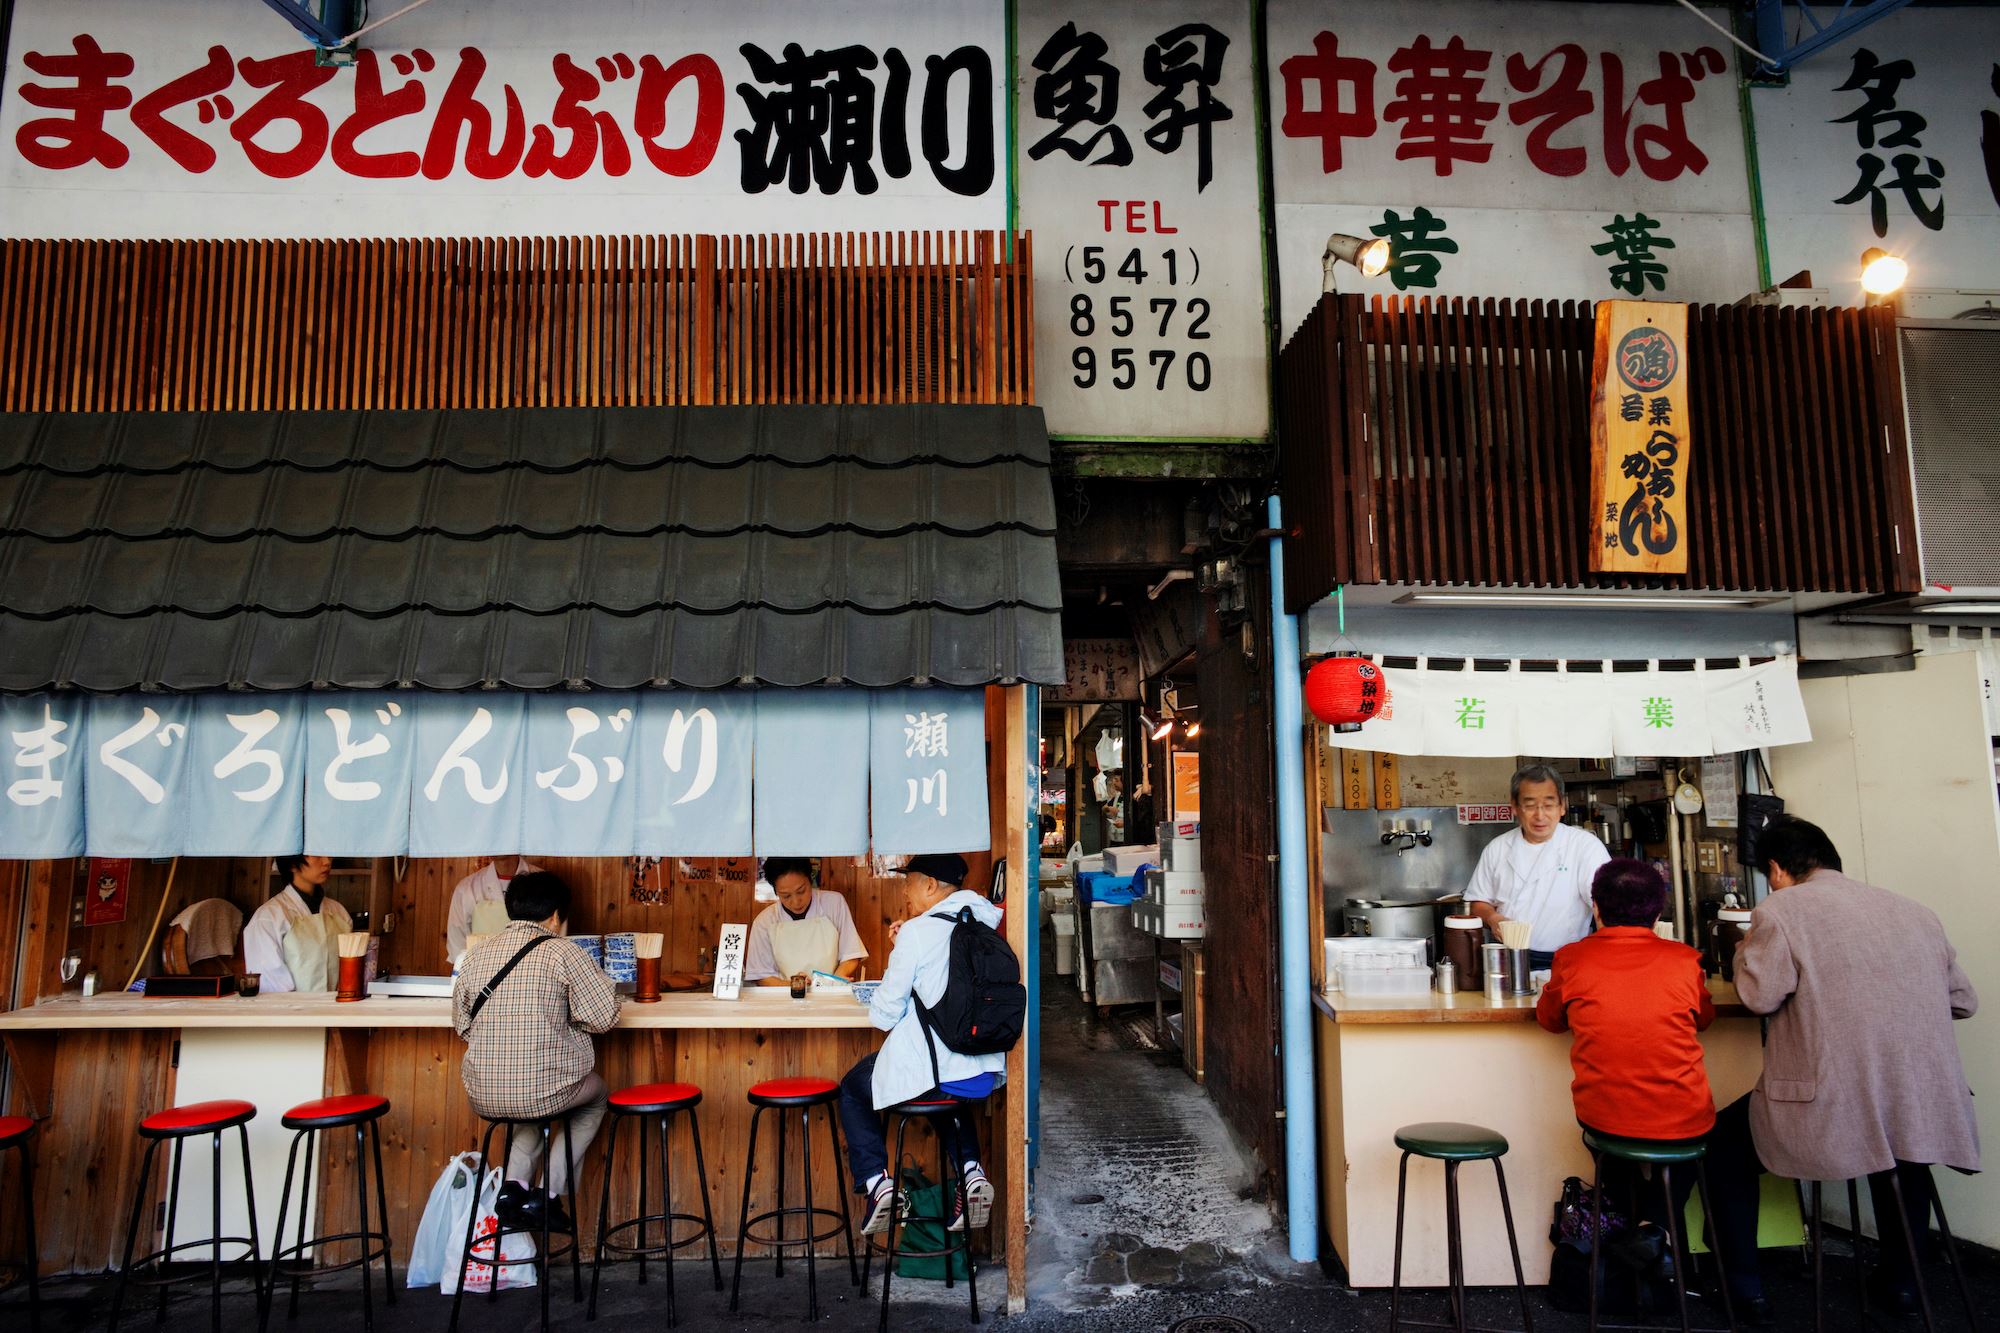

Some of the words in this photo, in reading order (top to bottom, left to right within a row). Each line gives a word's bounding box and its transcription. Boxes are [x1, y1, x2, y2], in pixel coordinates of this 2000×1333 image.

[15, 33, 726, 180] まぐろどんぶり
[734, 42, 995, 196] 瀬川
[1027, 20, 1234, 195] 魚昇
[1280, 30, 1727, 182] 中華そば
[1824, 47, 1946, 238] 名代
[1097, 200, 1178, 234] TEL
[1065, 245, 1200, 286] (541)
[1070, 294, 1211, 339] 8572
[1071, 346, 1212, 391] 9570
[6, 701, 718, 807] まぐろどんぶり
[1454, 697, 1487, 730] 若
[1641, 697, 1675, 730] 葉
[905, 711, 950, 818] 瀬川
[720, 933, 741, 991] 営業中
